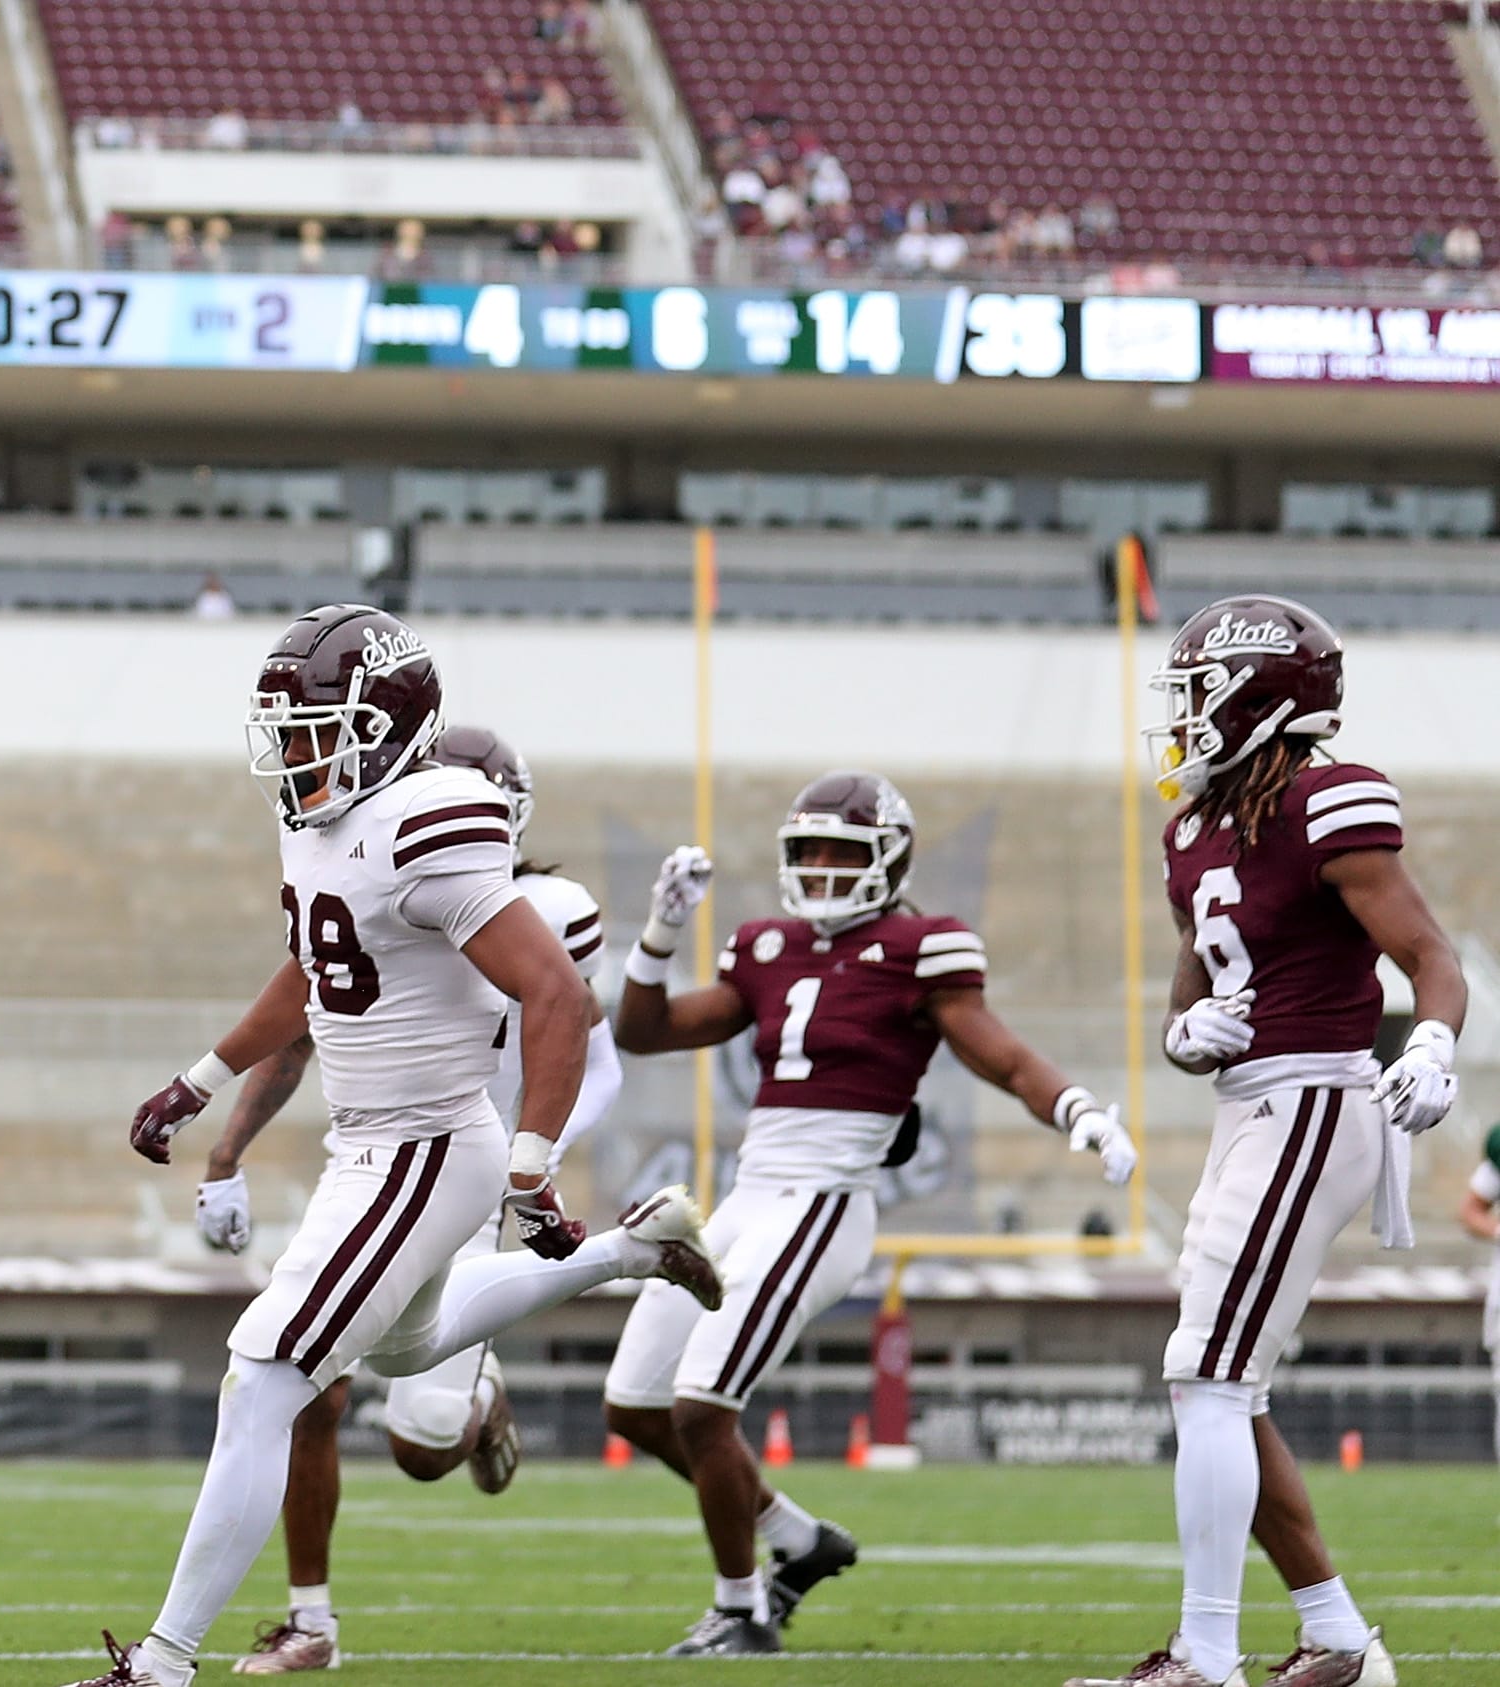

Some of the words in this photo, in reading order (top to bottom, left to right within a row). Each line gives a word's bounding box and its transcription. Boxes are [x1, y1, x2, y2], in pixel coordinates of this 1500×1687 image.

[253, 293, 291, 351] 2
[464, 284, 524, 368] 4
[651, 287, 708, 370] 6
[807, 290, 903, 375] 14
[362, 627, 429, 672] State
[1204, 613, 1293, 654] State
[1192, 866, 1254, 998] 6
[774, 977, 822, 1082] 1
